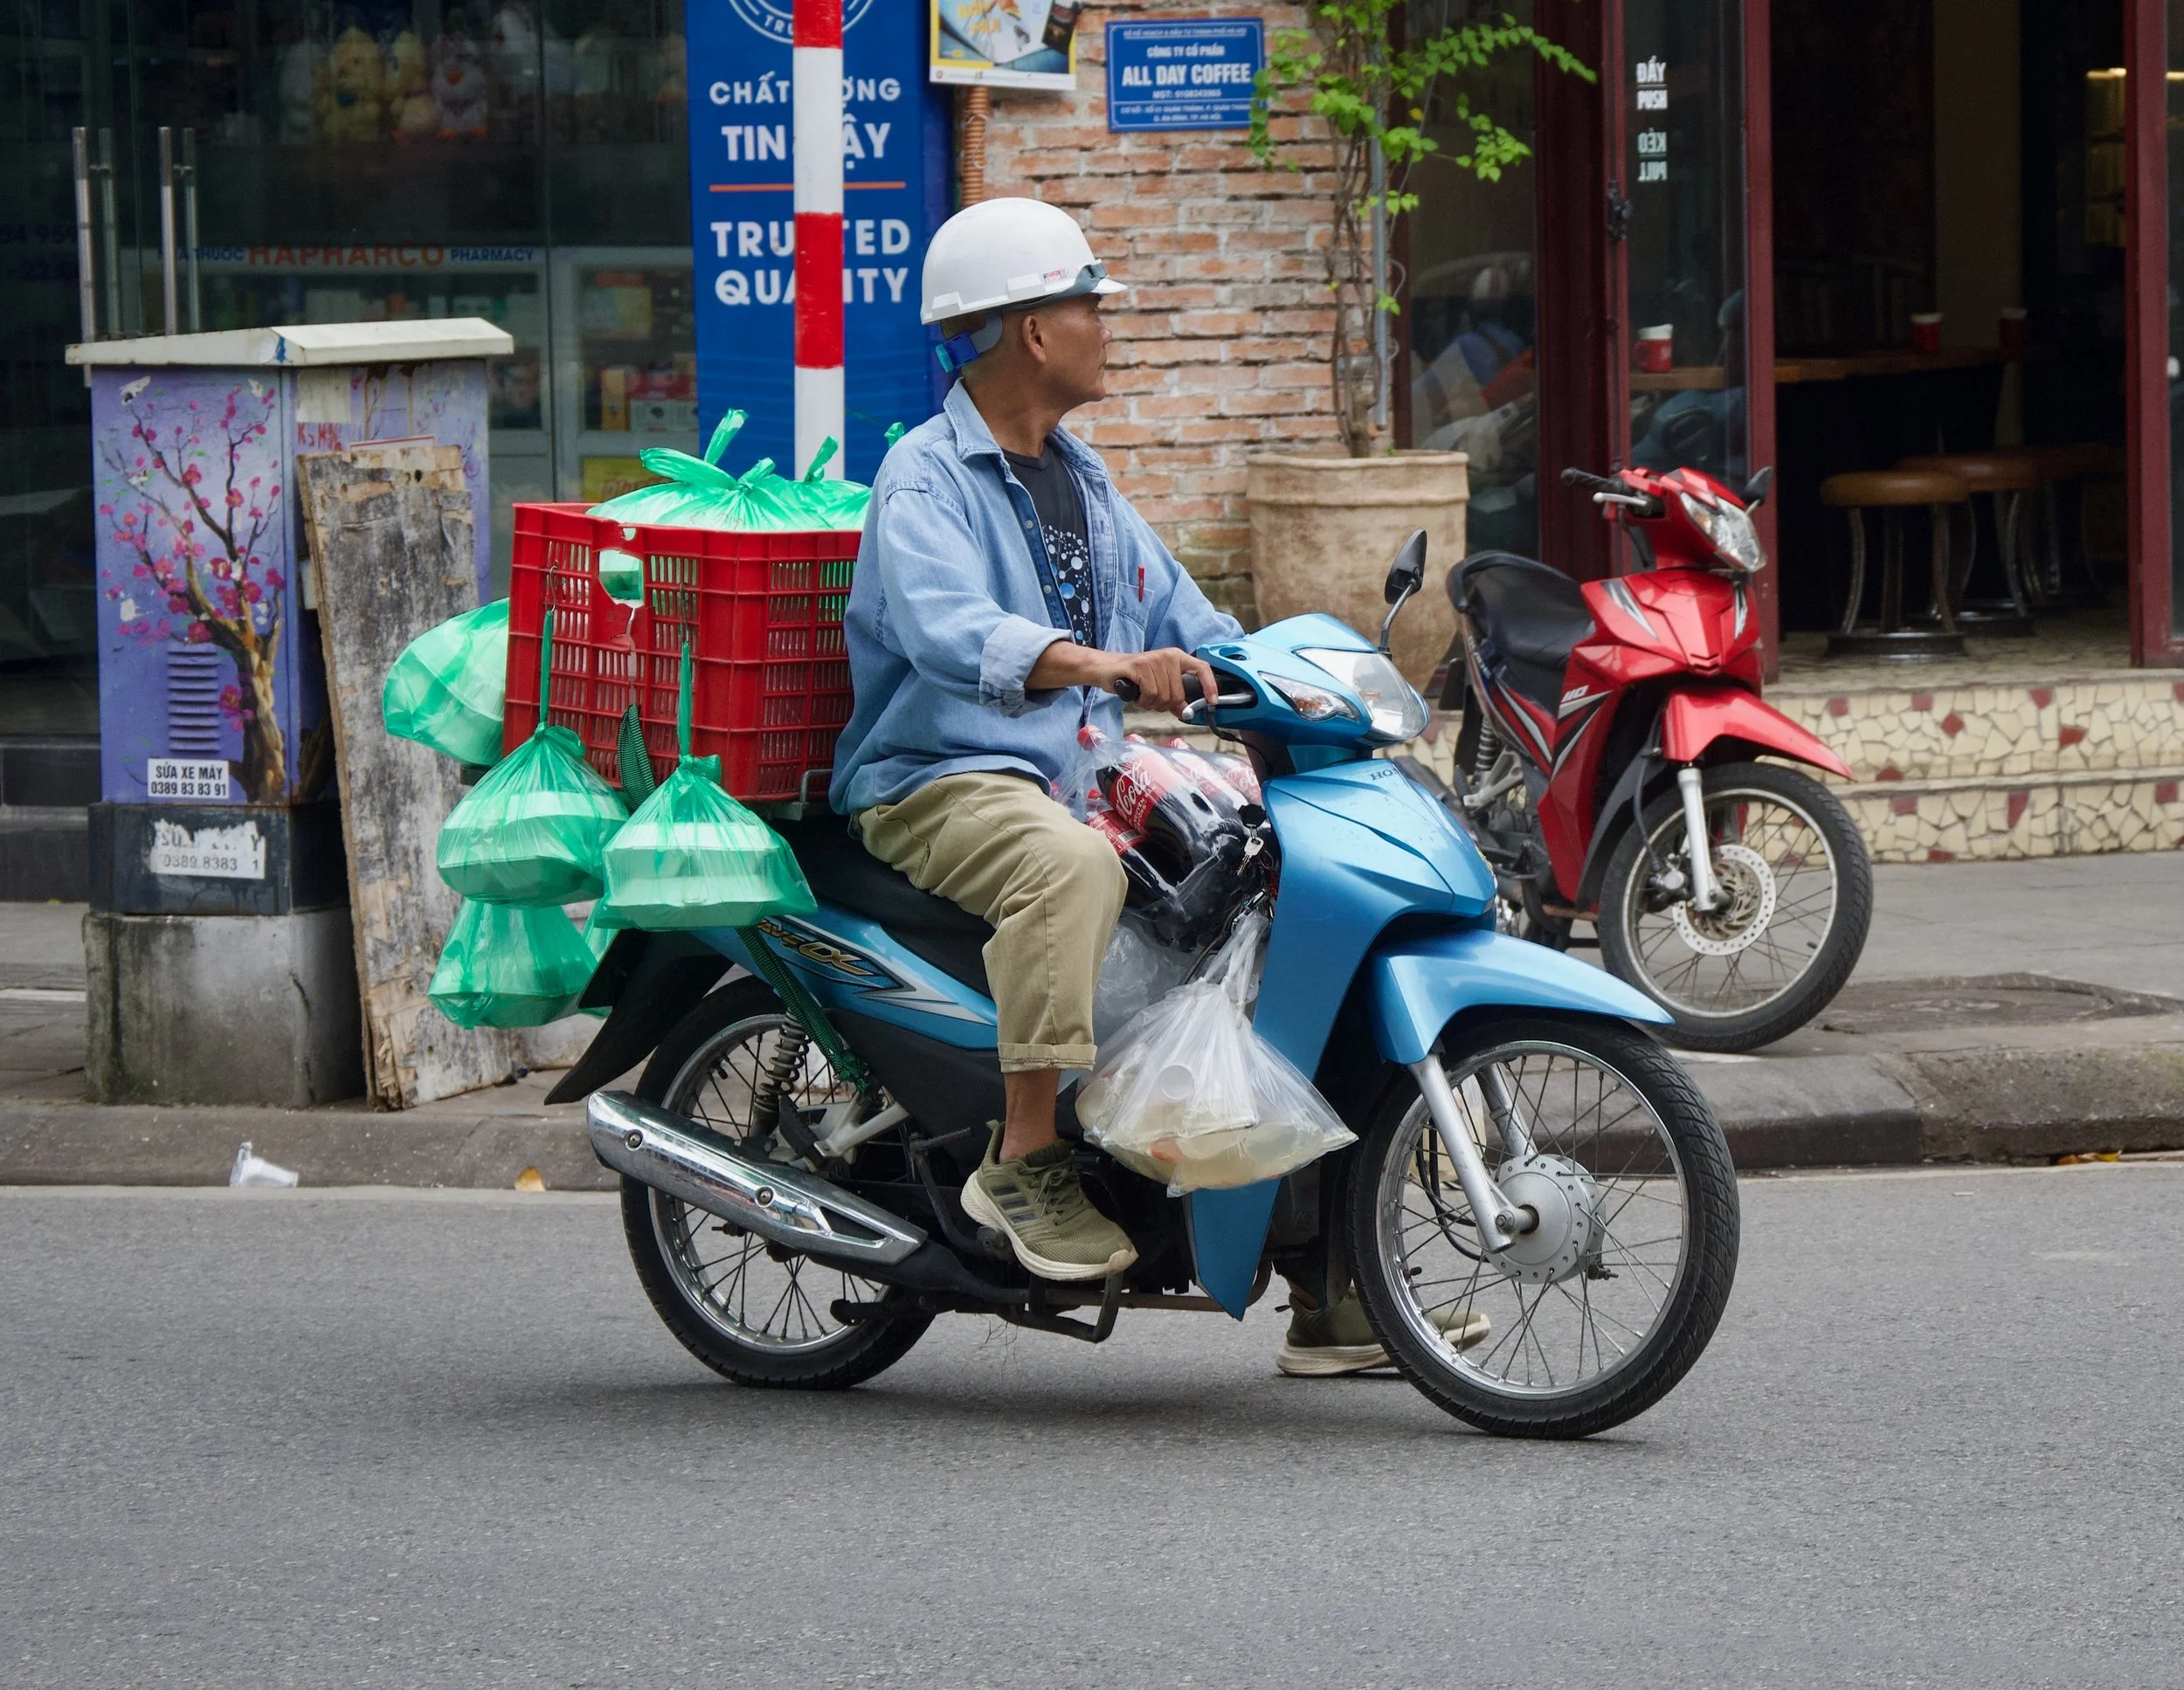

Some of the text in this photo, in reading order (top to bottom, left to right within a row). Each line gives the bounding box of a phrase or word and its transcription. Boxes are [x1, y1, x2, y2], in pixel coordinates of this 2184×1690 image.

[1122, 63, 1251, 86] ALL DAY COFFEE
[709, 71, 791, 104] CHẤT
[842, 76, 901, 107] ỢNG
[1636, 90, 1668, 110] PUSH
[722, 113, 891, 169] TIN ẬY
[710, 218, 910, 257] TRUED
[248, 244, 444, 267] HAPHARCO
[450, 248, 534, 261] PHARMACY
[715, 267, 909, 306] QUITY
[181, 767, 194, 779] XE
[198, 765, 223, 780] MÁY
[151, 782, 226, 797] 0389 83 83 91
